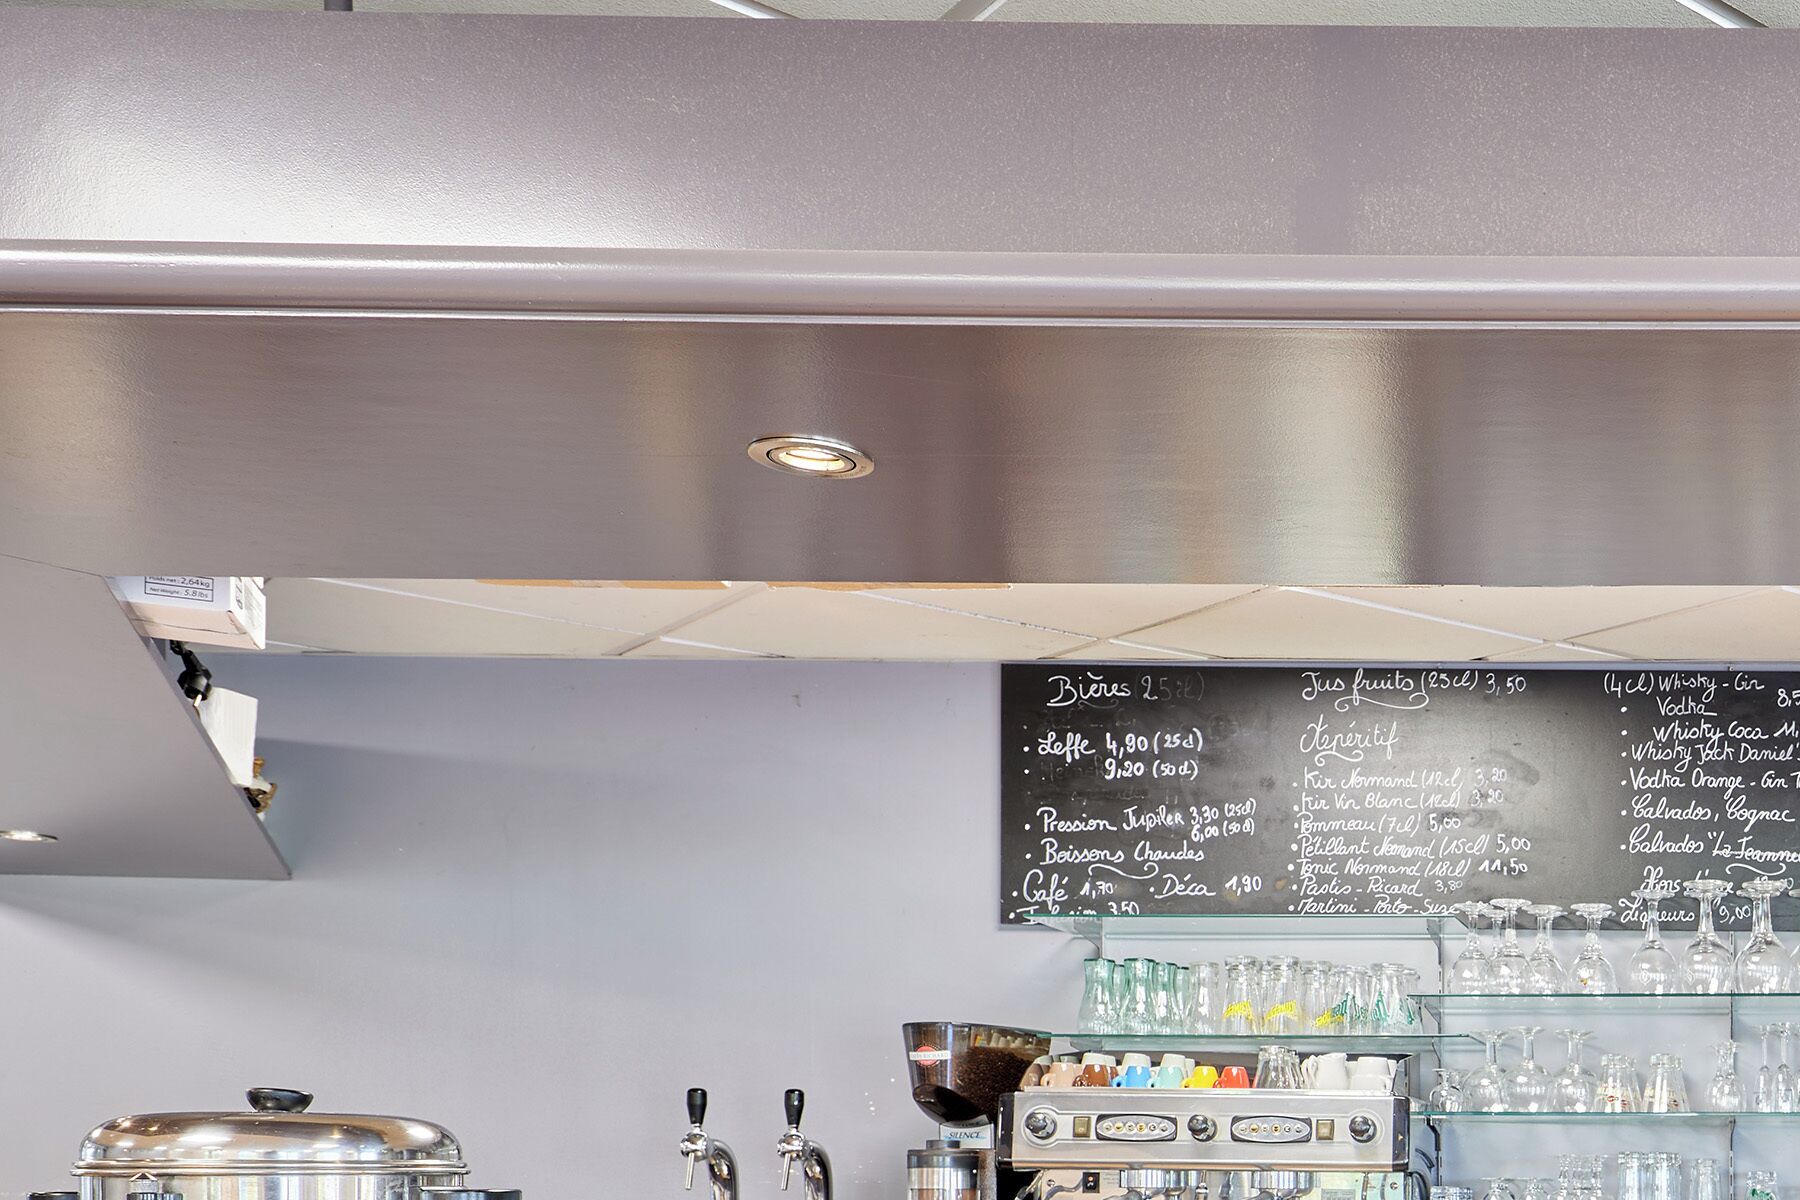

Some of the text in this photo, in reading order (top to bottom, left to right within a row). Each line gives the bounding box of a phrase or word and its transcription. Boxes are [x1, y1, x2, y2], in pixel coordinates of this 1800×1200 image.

[1047, 671, 1131, 706] Bières
[1301, 672, 1345, 700] Jus
[1353, 668, 1414, 705] fruits
[1485, 672, 1527, 695] 3,50
[1658, 673, 1718, 702] Whisky
[1734, 672, 1765, 691] Gin
[1656, 696, 1717, 716] Vodka
[1038, 731, 1096, 763] Leffe
[1105, 732, 1149, 759] 4,90
[1653, 719, 1724, 749] Whisky
[1727, 720, 1769, 739] Coca
[1104, 760, 1145, 780] 9,20
[1631, 740, 1692, 772] Whisky
[1695, 741, 1734, 765] Jack
[1304, 767, 1337, 789] Kir
[1341, 768, 1417, 789] Normand
[1630, 766, 1685, 790] Vodka
[1692, 767, 1745, 799] Orange
[1761, 770, 1788, 788] Gin
[1301, 792, 1329, 811] Kir
[1335, 792, 1360, 809] Vin
[1365, 792, 1417, 809] Blanc
[1725, 794, 1796, 832] Cognac
[1036, 806, 1118, 833] Pression
[1189, 806, 1219, 825] 3,30
[1297, 812, 1376, 834] Pommeau
[1429, 814, 1461, 832] 5,00
[1040, 837, 1205, 866] Boissons Chaudes
[1297, 834, 1370, 858] Pétillant
[1496, 834, 1531, 854] 5,00
[1629, 823, 1704, 854] Calvados
[1297, 859, 1338, 876] Tonic
[1344, 857, 1421, 876] Normand
[1478, 858, 1528, 875] 11,50
[1023, 868, 1069, 911] Café
[1154, 873, 1216, 899] Déca
[1225, 875, 1262, 897] 1,90
[1297, 876, 1352, 896] Pastis
[1367, 876, 1423, 896] Ricard
[1298, 898, 1358, 915] Martini
[1374, 895, 1413, 914] Porto
